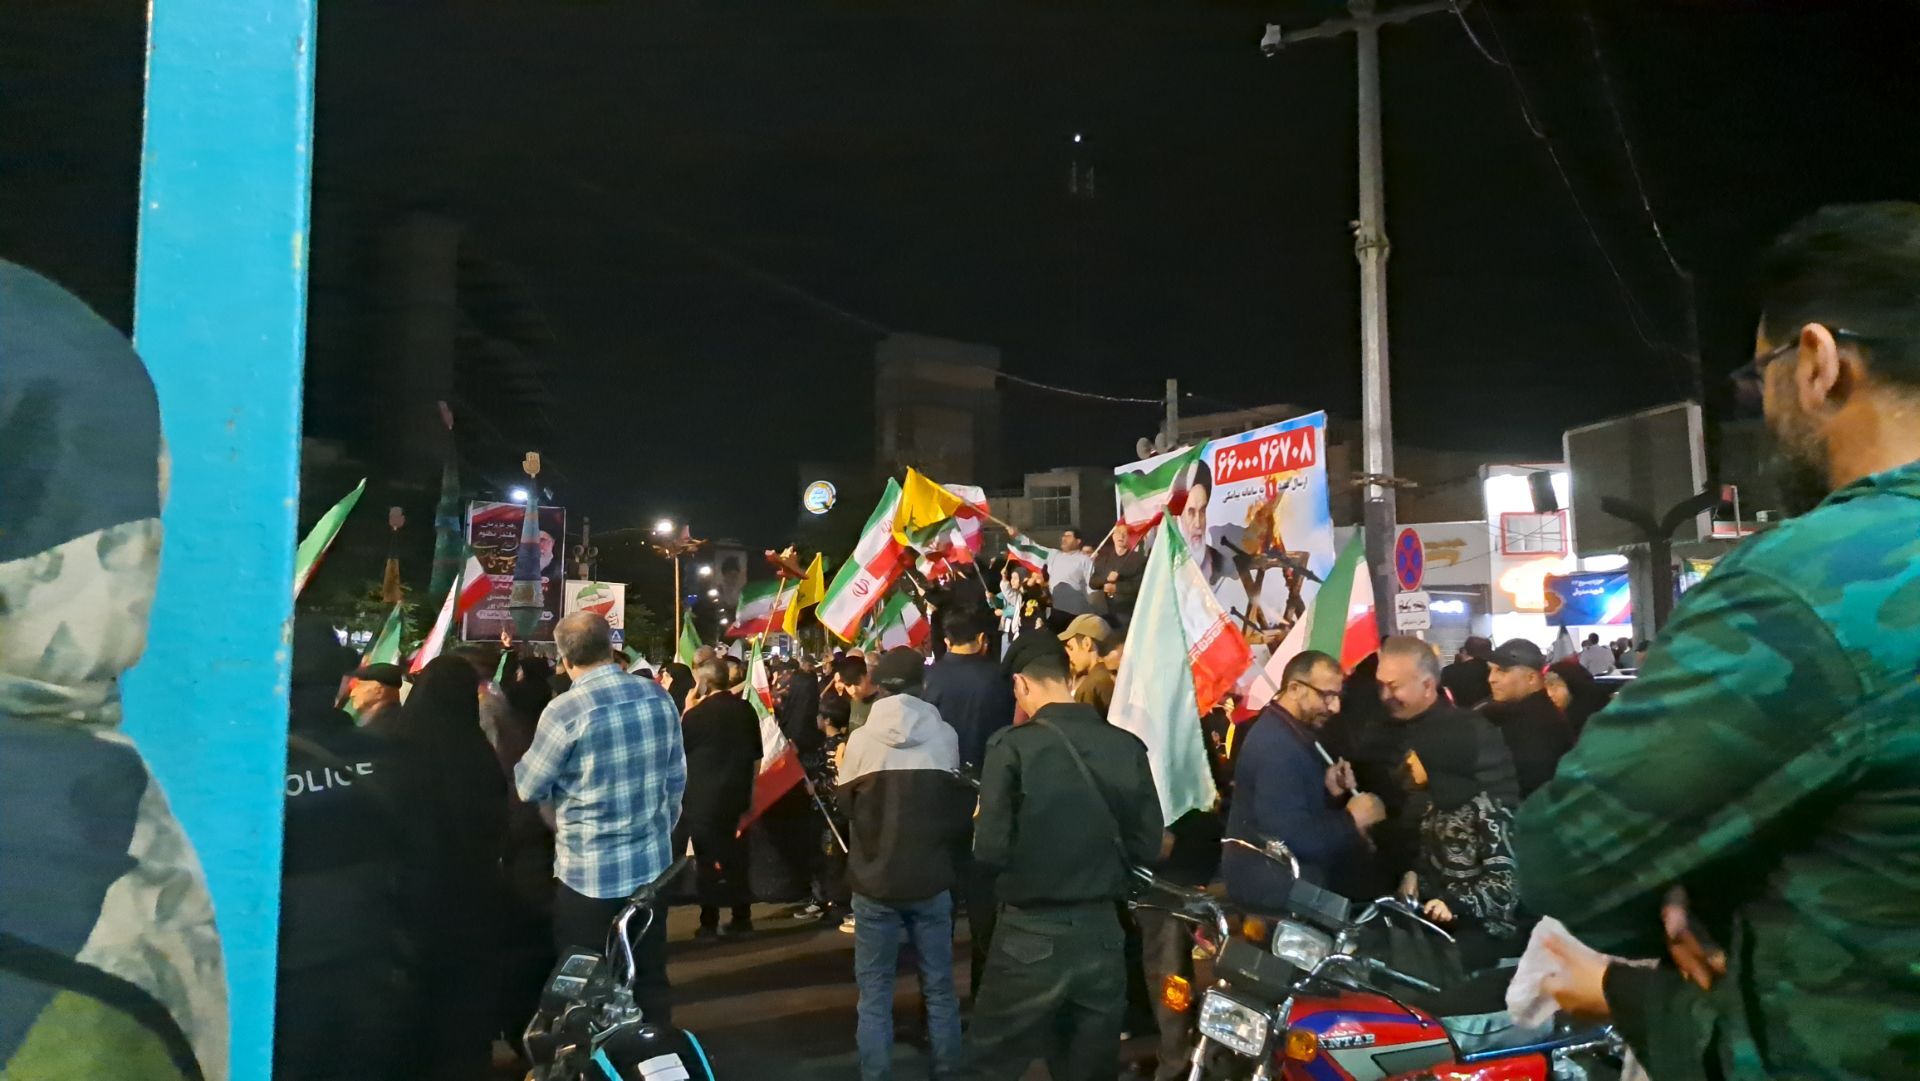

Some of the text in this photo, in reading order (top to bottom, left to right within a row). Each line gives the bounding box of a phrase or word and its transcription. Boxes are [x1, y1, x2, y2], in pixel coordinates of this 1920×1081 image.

[1217, 431, 1312, 481] ۶۶۰۰۰۲۶۷۰۸
[1291, 476, 1308, 491] ارسال
[286, 762, 374, 796] OLICE
